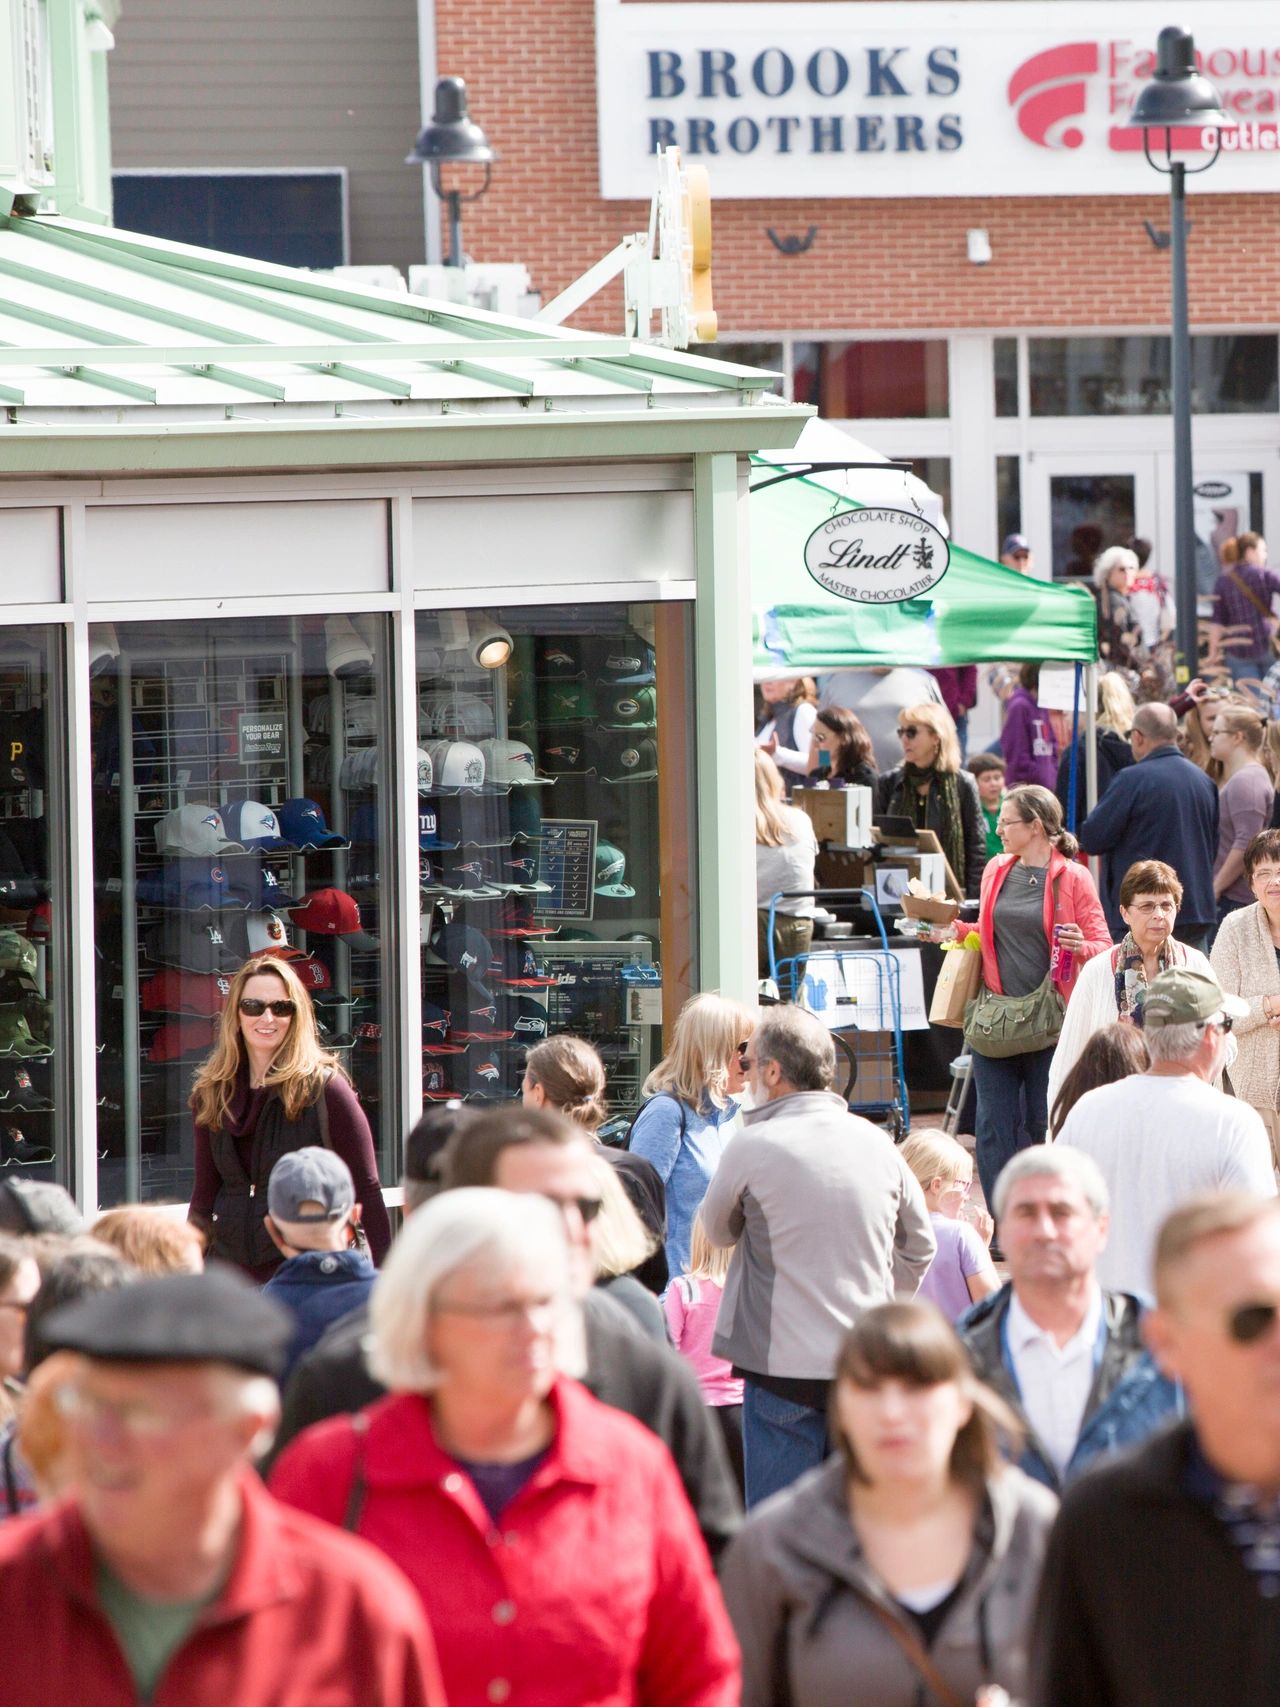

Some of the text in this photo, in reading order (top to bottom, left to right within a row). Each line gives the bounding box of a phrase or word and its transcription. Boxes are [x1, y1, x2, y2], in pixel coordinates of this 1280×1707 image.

[646, 47, 963, 100] BROOKS
[648, 114, 965, 155] BROTHERS
[824, 511, 930, 535] CHOCOLATE SHOP
[818, 538, 912, 570] Lindt
[818, 572, 935, 600] MASTER CHOCOLATIER
[242, 724, 283, 733] PERSONALIZE
[246, 731, 280, 741] YOUR GEAR
[10, 742, 23, 762] P
[211, 867, 225, 883] C
[261, 868, 278, 886] LA
[206, 926, 223, 944] LA
